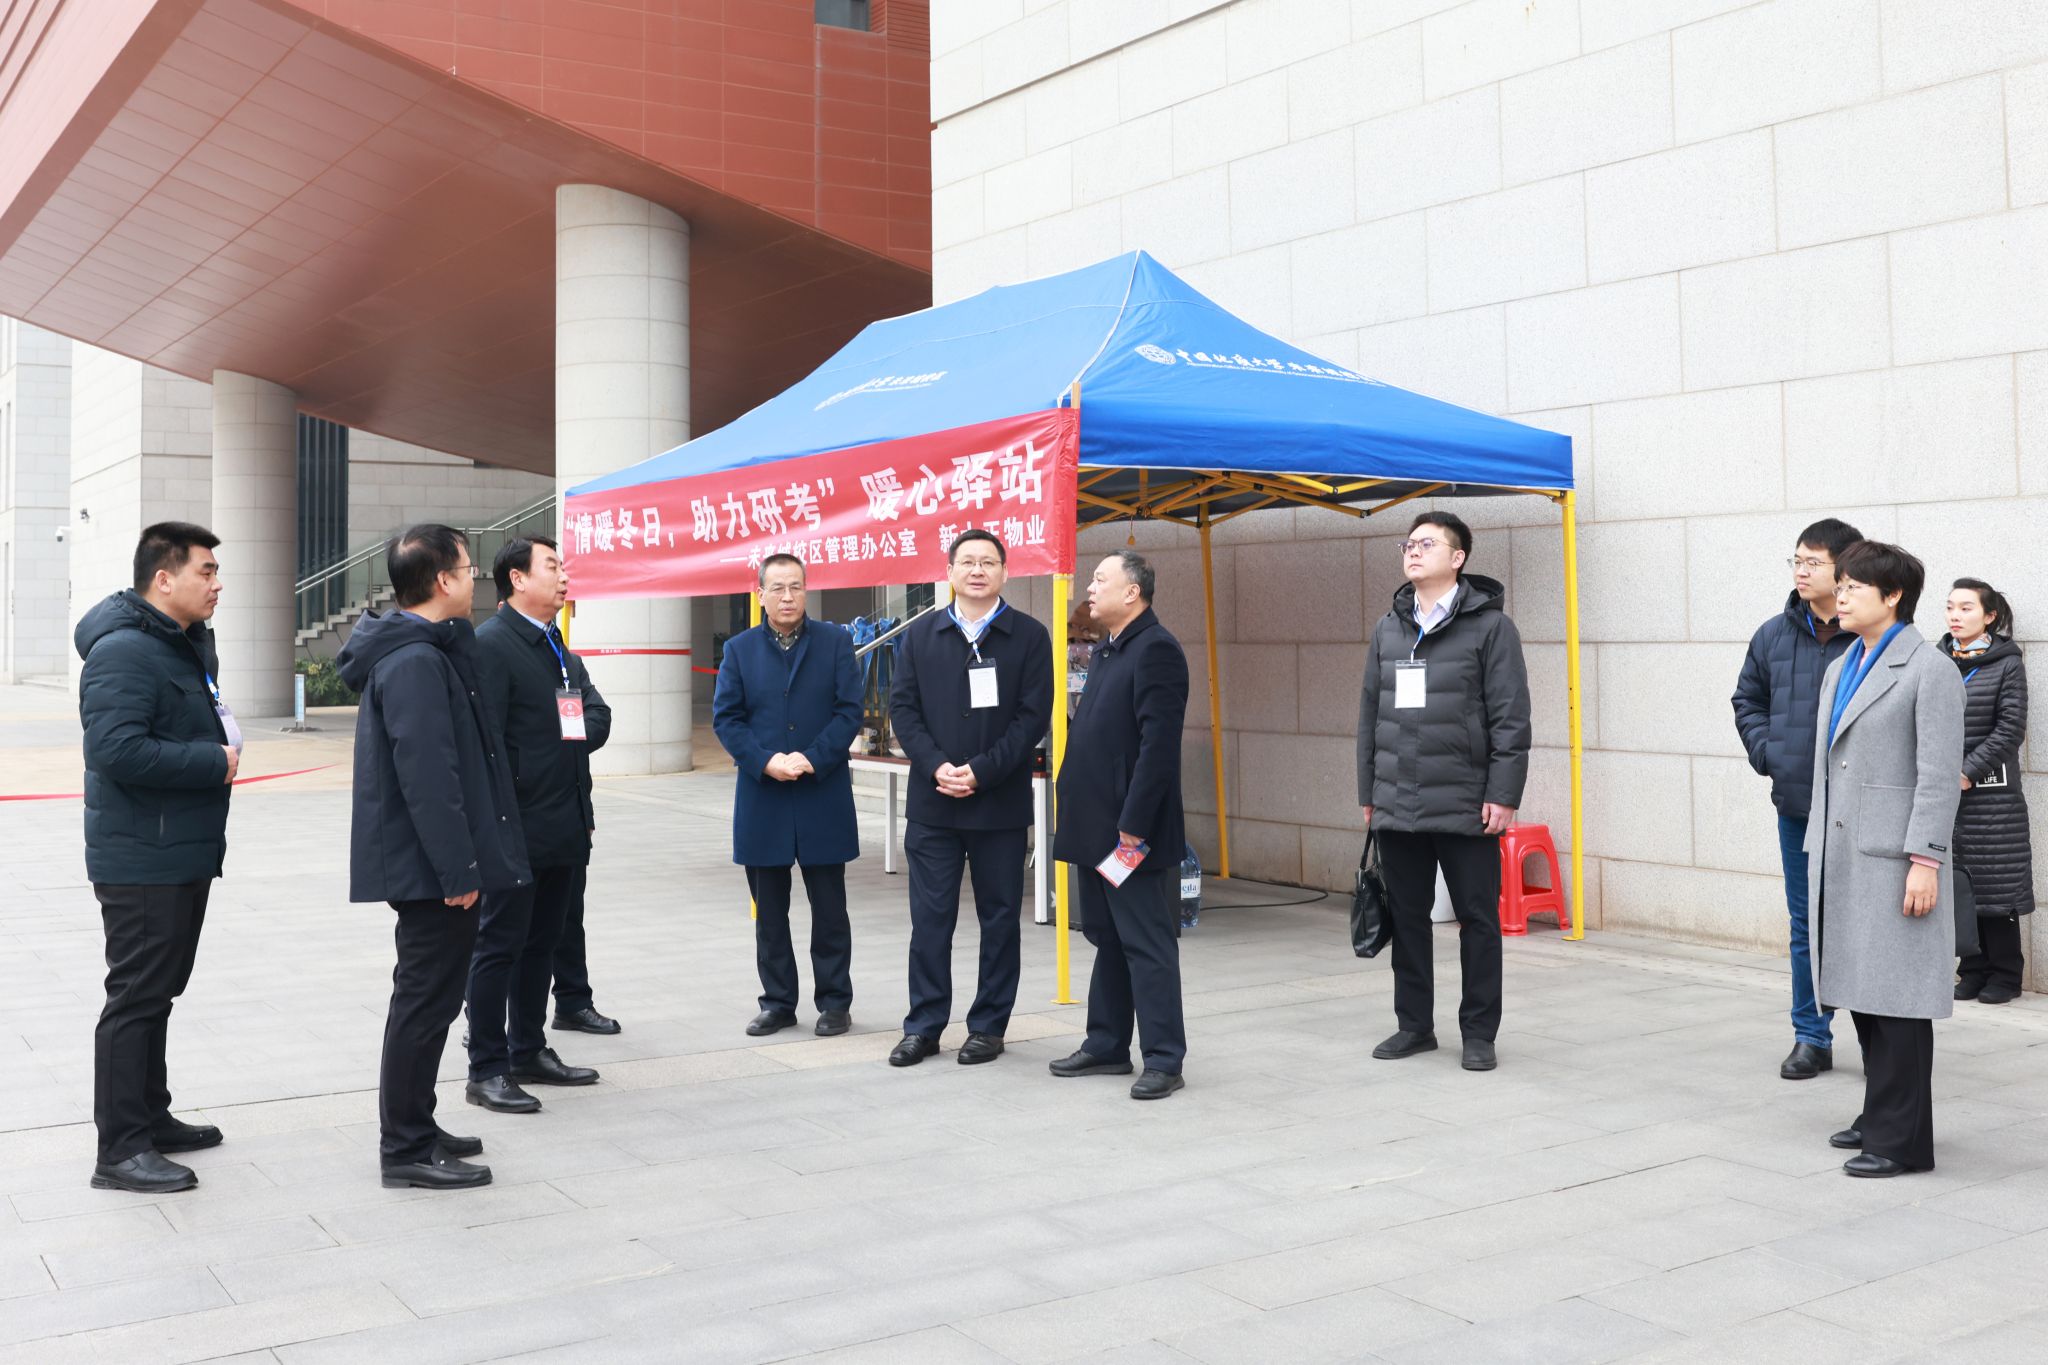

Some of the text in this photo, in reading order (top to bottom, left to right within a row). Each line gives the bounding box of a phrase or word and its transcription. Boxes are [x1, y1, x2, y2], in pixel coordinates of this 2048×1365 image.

[861, 440, 1045, 521] 暖心驿站
[1984, 775, 1998, 784] LIFE
